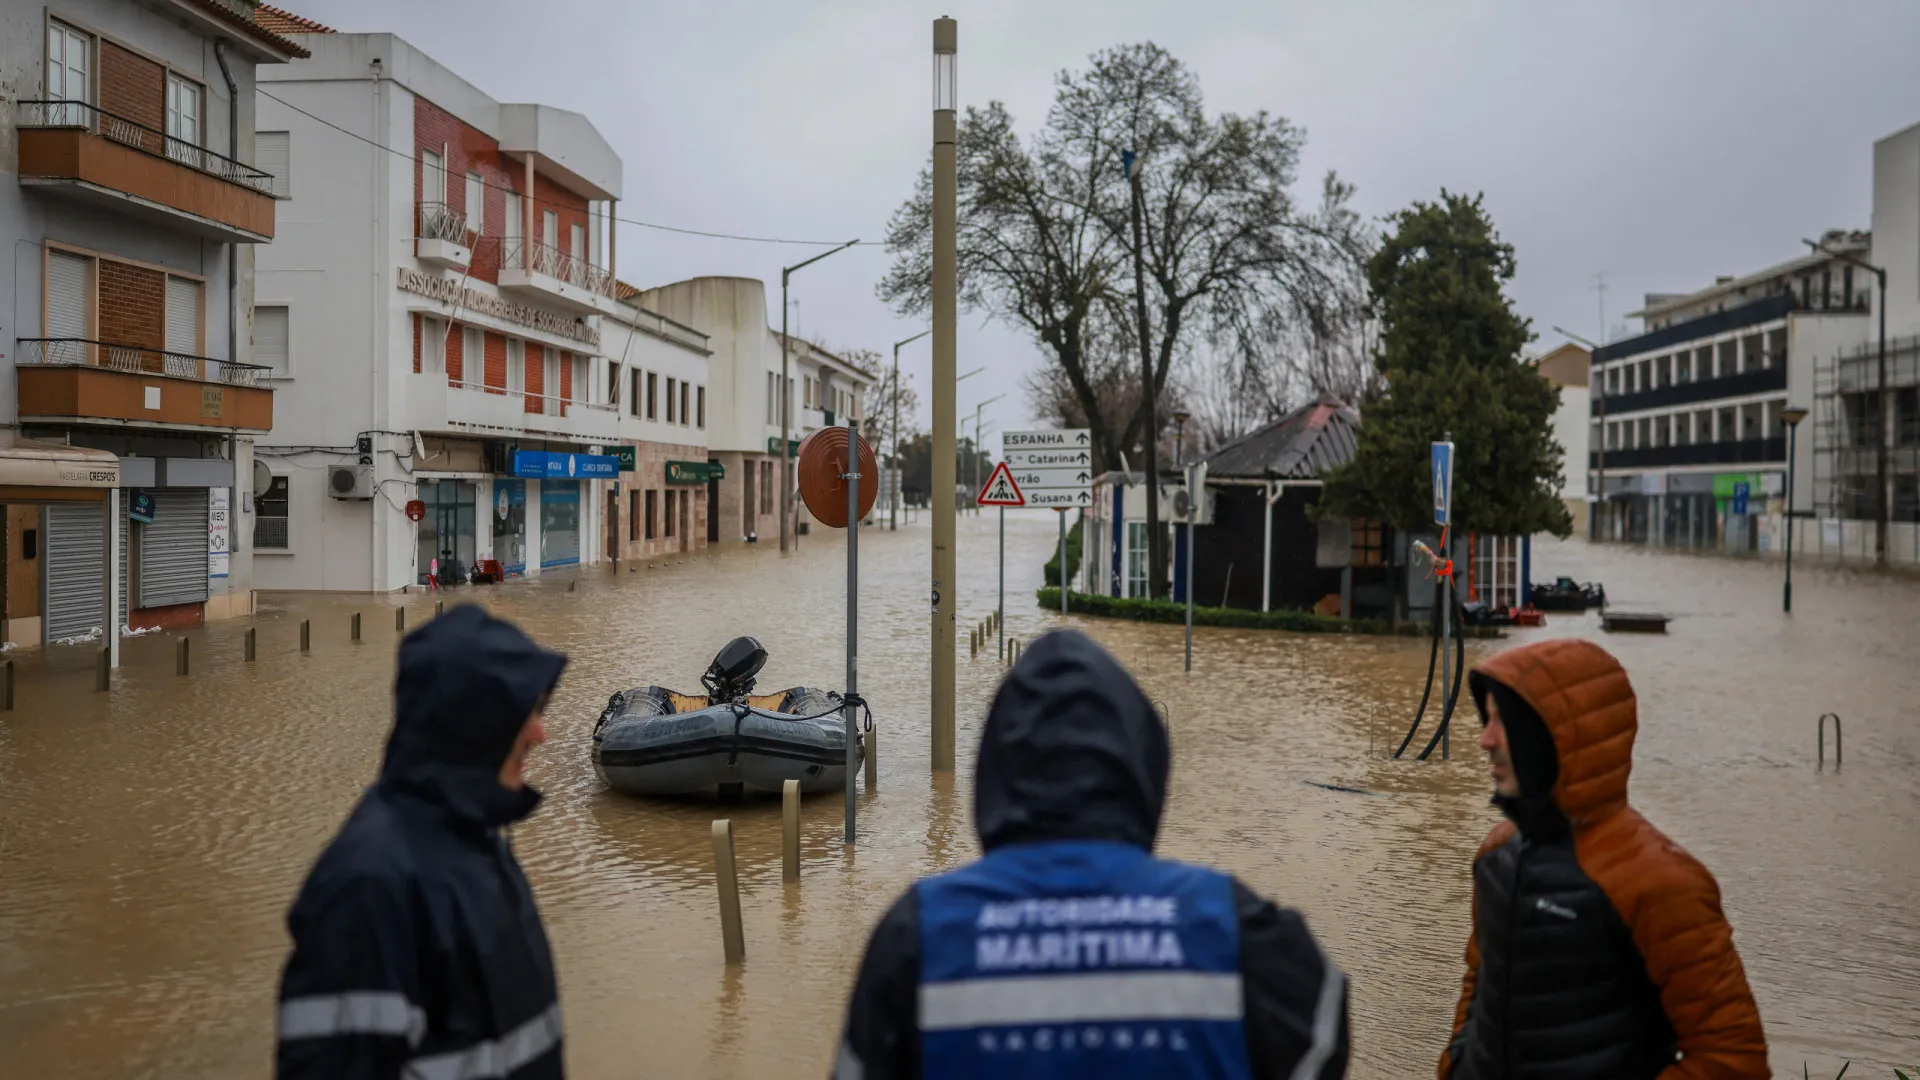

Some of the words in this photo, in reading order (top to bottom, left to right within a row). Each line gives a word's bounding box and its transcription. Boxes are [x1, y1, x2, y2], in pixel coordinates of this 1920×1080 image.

[526, 307, 536, 326] DE
[537, 311, 575, 338] SOCORROS
[1003, 434, 1065, 445] ESPANHA
[620, 453, 633, 462] CA
[1028, 454, 1076, 464] Catarina
[59, 471, 89, 481] PASTELARIA
[89, 471, 116, 482] CRESPO'S
[1014, 474, 1041, 484] rrão
[1031, 493, 1073, 503] Susana
[210, 511, 225, 522] MEO
[210, 534, 225, 550] NOS
[976, 895, 1178, 929] AUTORIDADE
[975, 930, 1184, 970] MARÍTIMA
